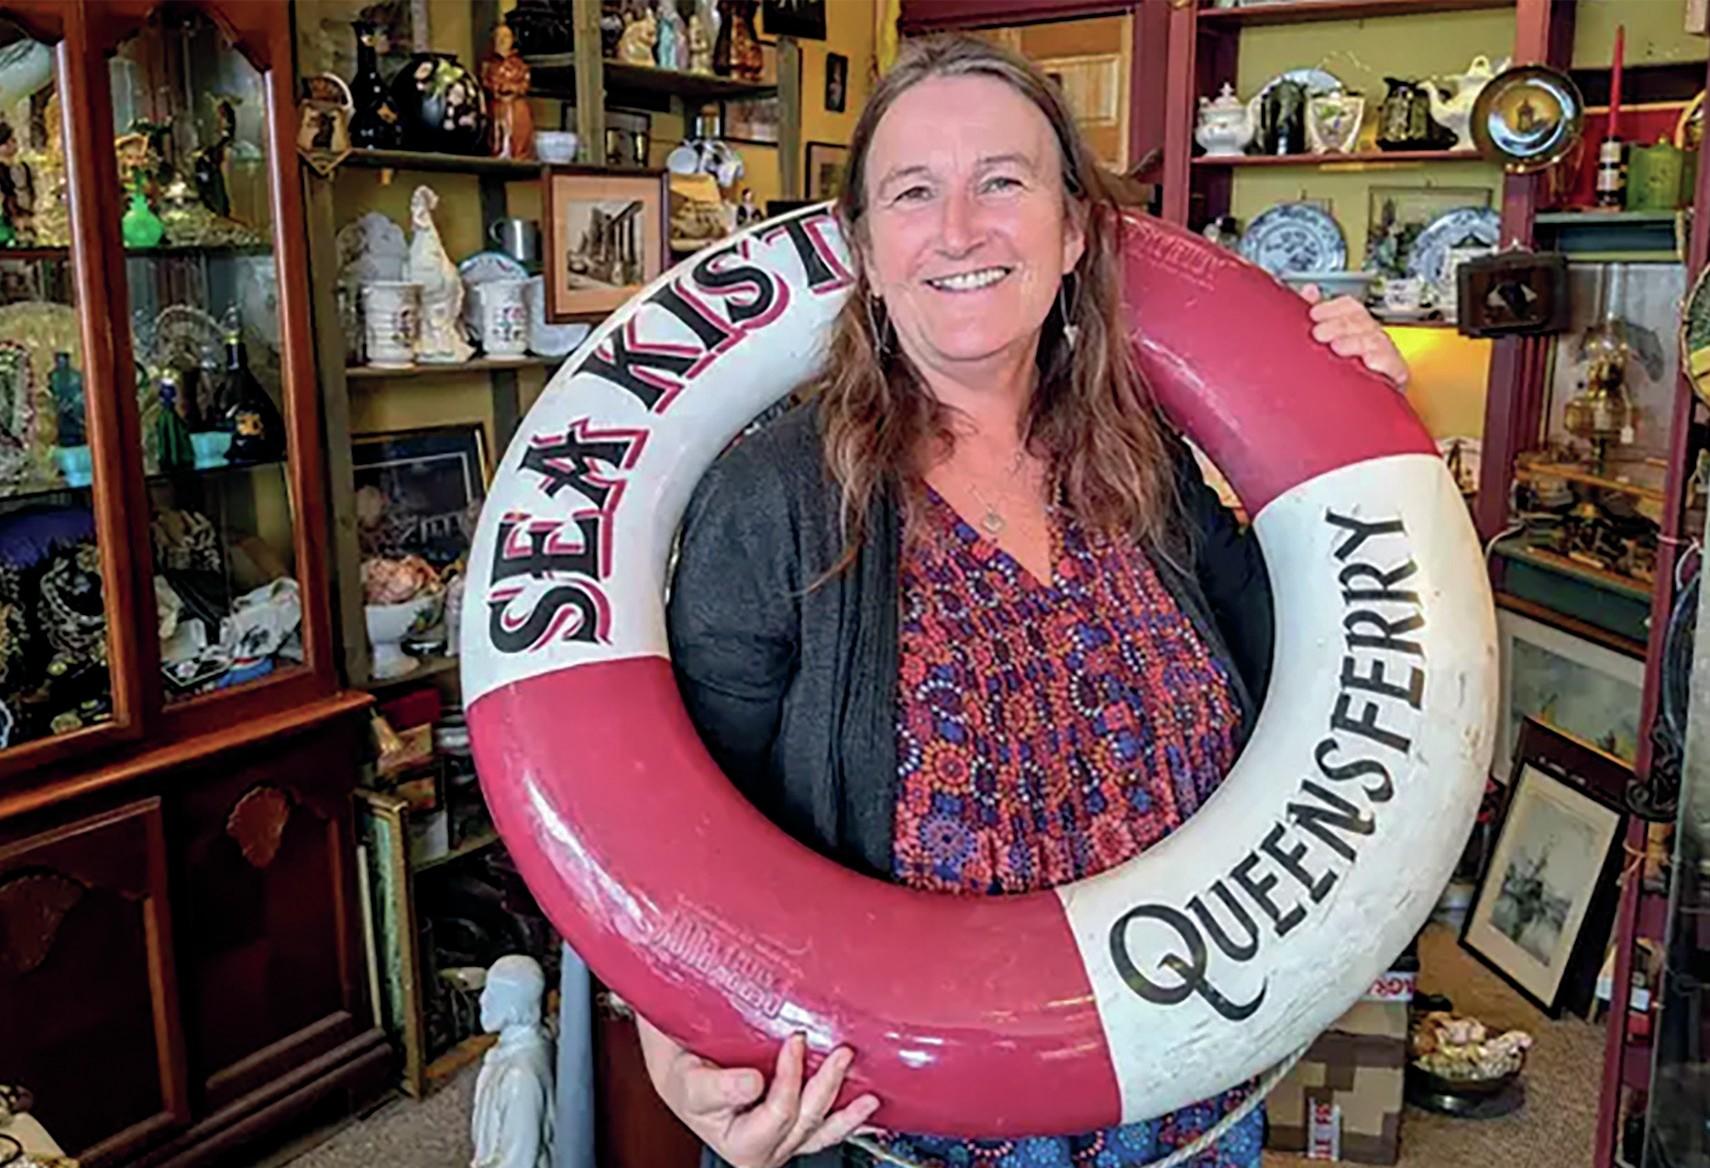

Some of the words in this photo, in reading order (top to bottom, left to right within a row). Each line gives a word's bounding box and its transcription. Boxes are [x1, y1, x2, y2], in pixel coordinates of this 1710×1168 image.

[488, 417, 650, 654] SEA
[572, 206, 855, 415] KIST
[1109, 506, 1427, 1022] QUEENSFERRY
